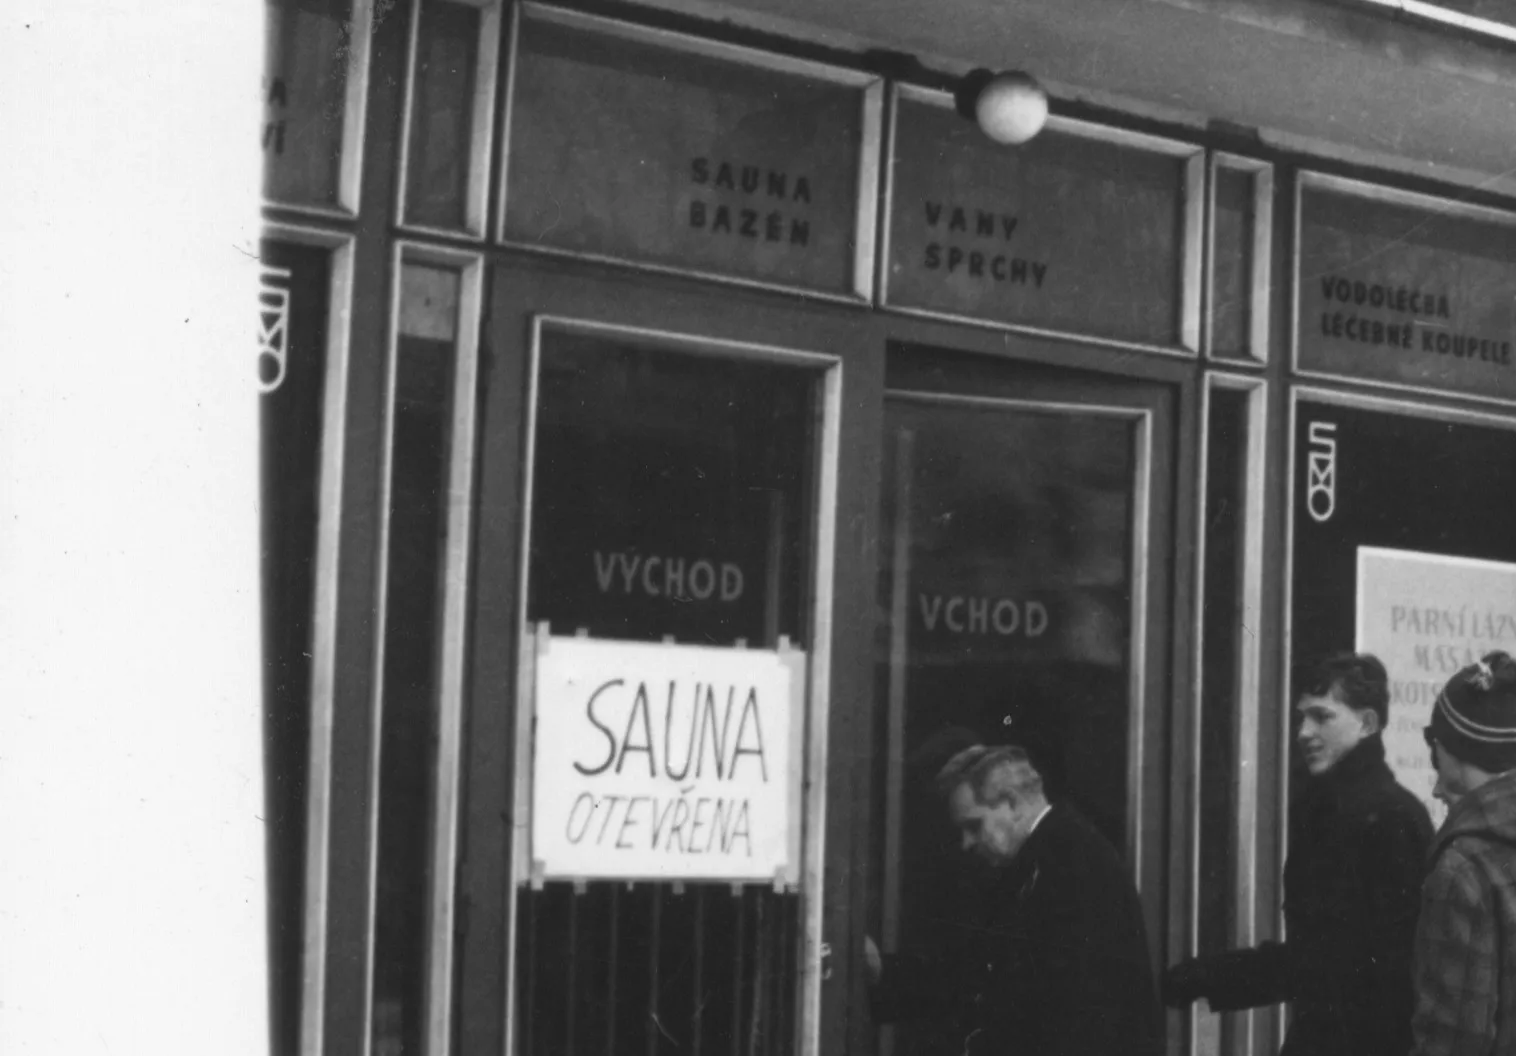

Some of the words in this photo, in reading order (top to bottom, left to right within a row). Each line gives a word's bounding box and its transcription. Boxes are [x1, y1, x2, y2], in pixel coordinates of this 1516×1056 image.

[691, 156, 811, 204] SAUNA
[925, 200, 1018, 241] VANY
[924, 242, 1047, 288] SPRCHY
[1422, 329, 1512, 366] KOUPELE
[919, 592, 1049, 638] VCHOD
[573, 678, 768, 783] SAUNA
[565, 784, 752, 858] OTEVŘENA
